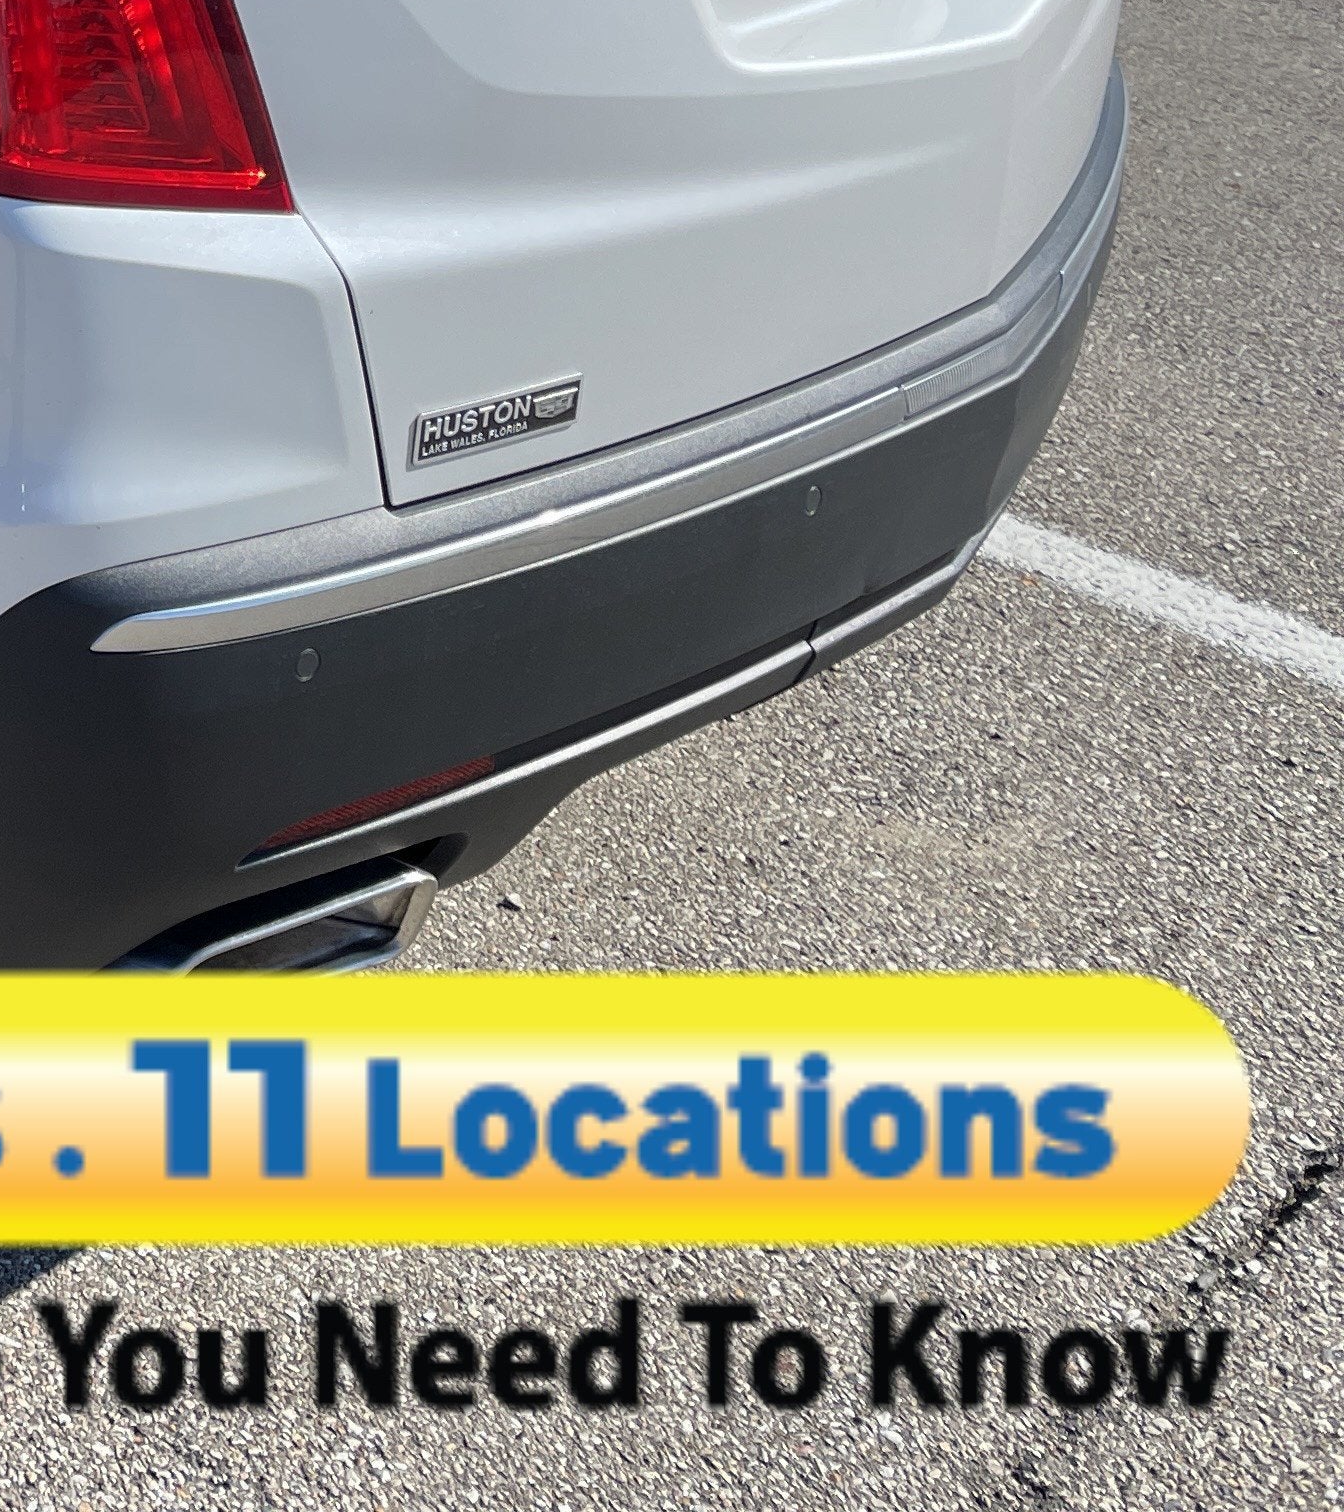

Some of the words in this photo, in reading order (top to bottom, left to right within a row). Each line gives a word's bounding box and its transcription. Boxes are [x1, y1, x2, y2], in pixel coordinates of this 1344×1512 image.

[420, 442, 449, 457] LAKE
[487, 420, 529, 440] FLORIDA
[422, 394, 533, 443] HUSTON
